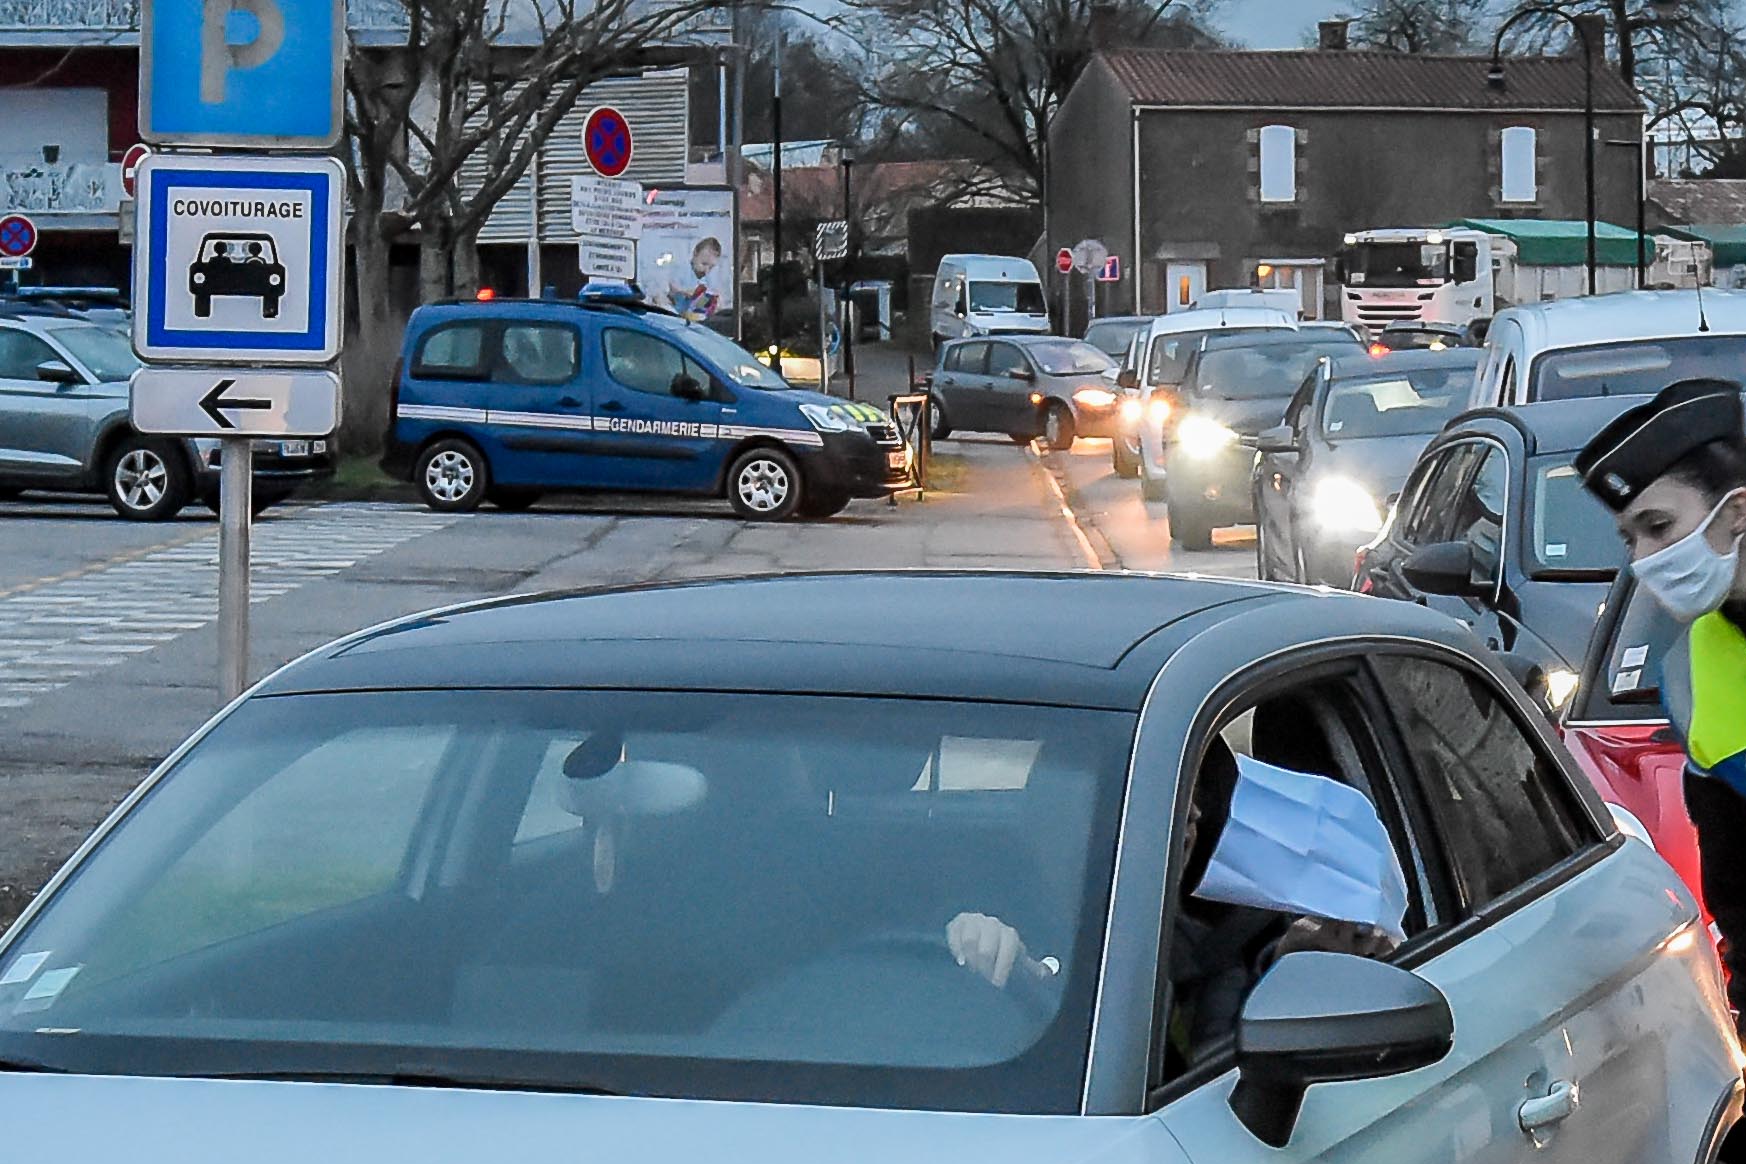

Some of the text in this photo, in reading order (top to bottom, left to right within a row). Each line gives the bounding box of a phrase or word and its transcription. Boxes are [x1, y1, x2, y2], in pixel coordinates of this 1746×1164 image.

[202, 0, 284, 104] P
[173, 199, 303, 219] COVOITURAGE
[610, 417, 700, 437] GENDARMERIE
